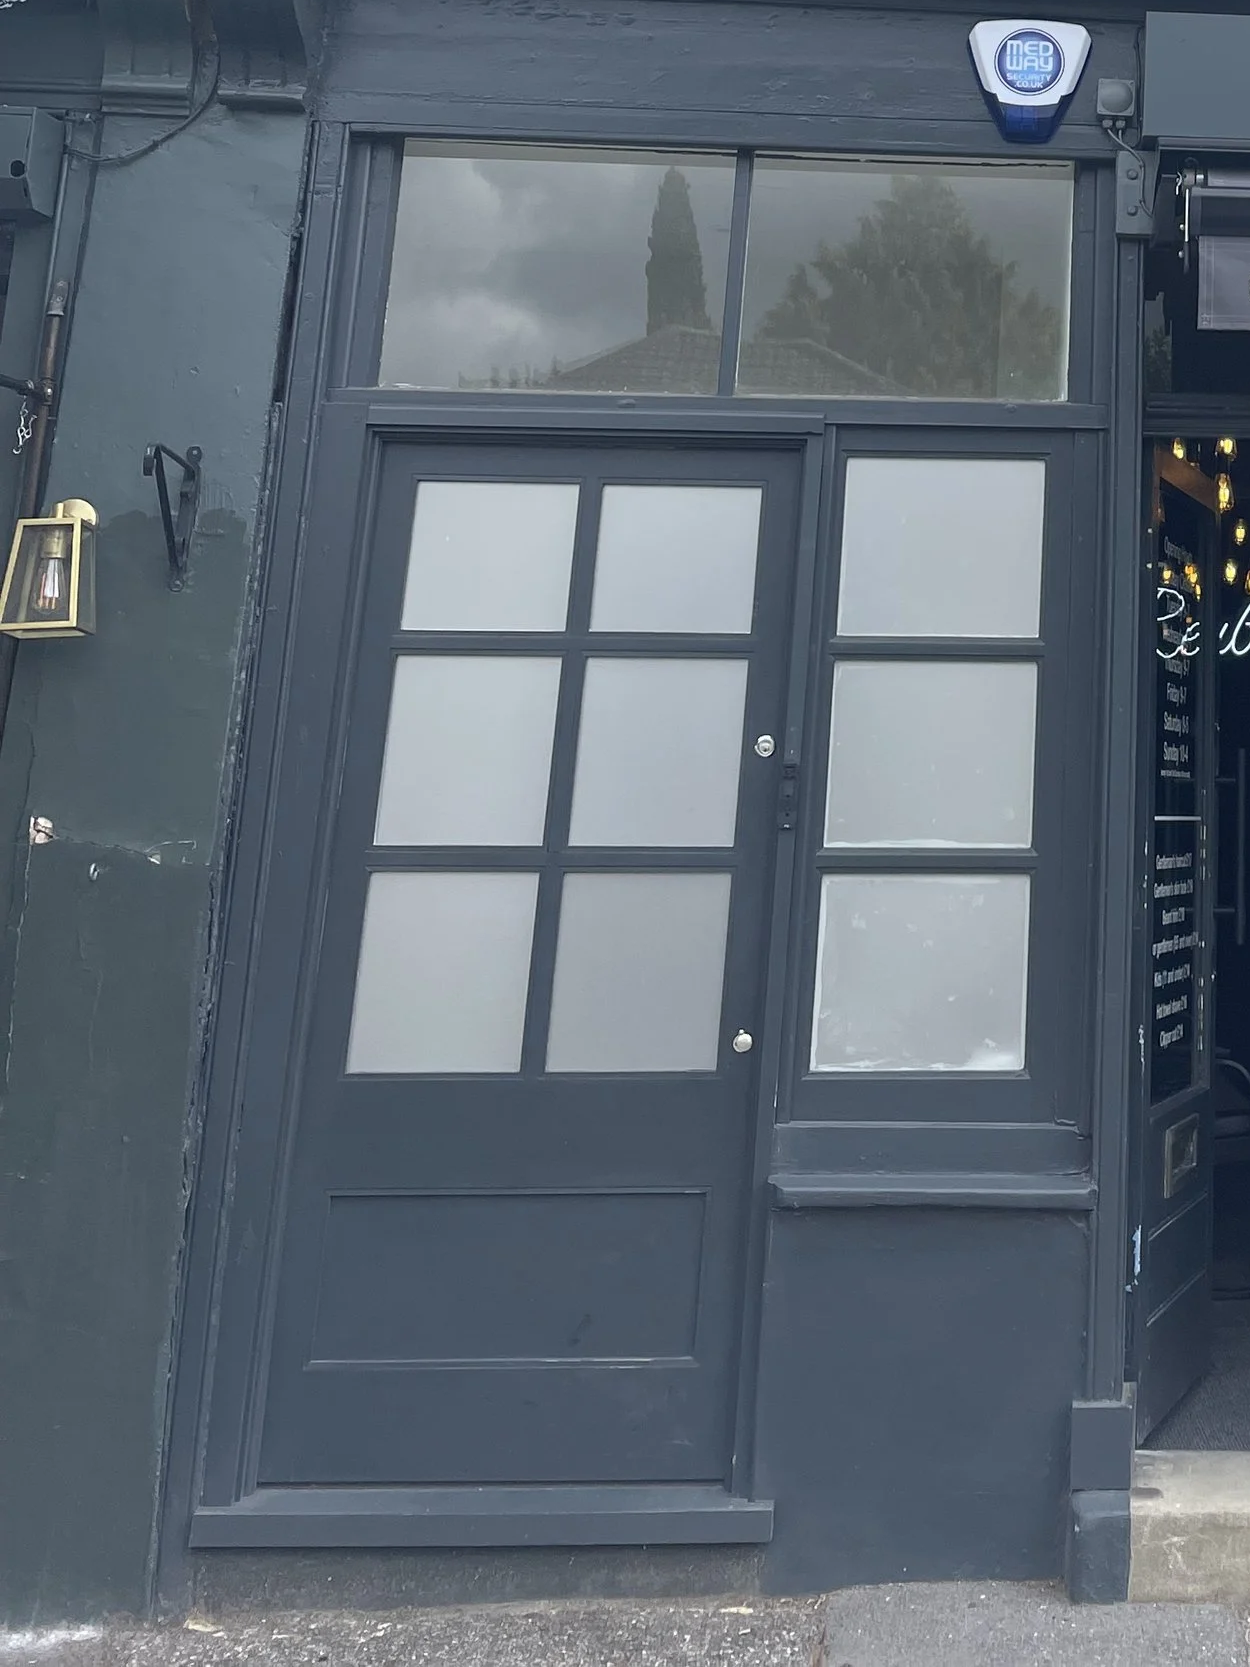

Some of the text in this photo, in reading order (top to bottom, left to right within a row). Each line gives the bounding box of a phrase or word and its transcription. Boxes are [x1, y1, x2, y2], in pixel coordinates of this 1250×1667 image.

[1006, 39, 1053, 56] MED
[1006, 56, 1054, 72] WAY
[1006, 72, 1052, 81] SECURITY
